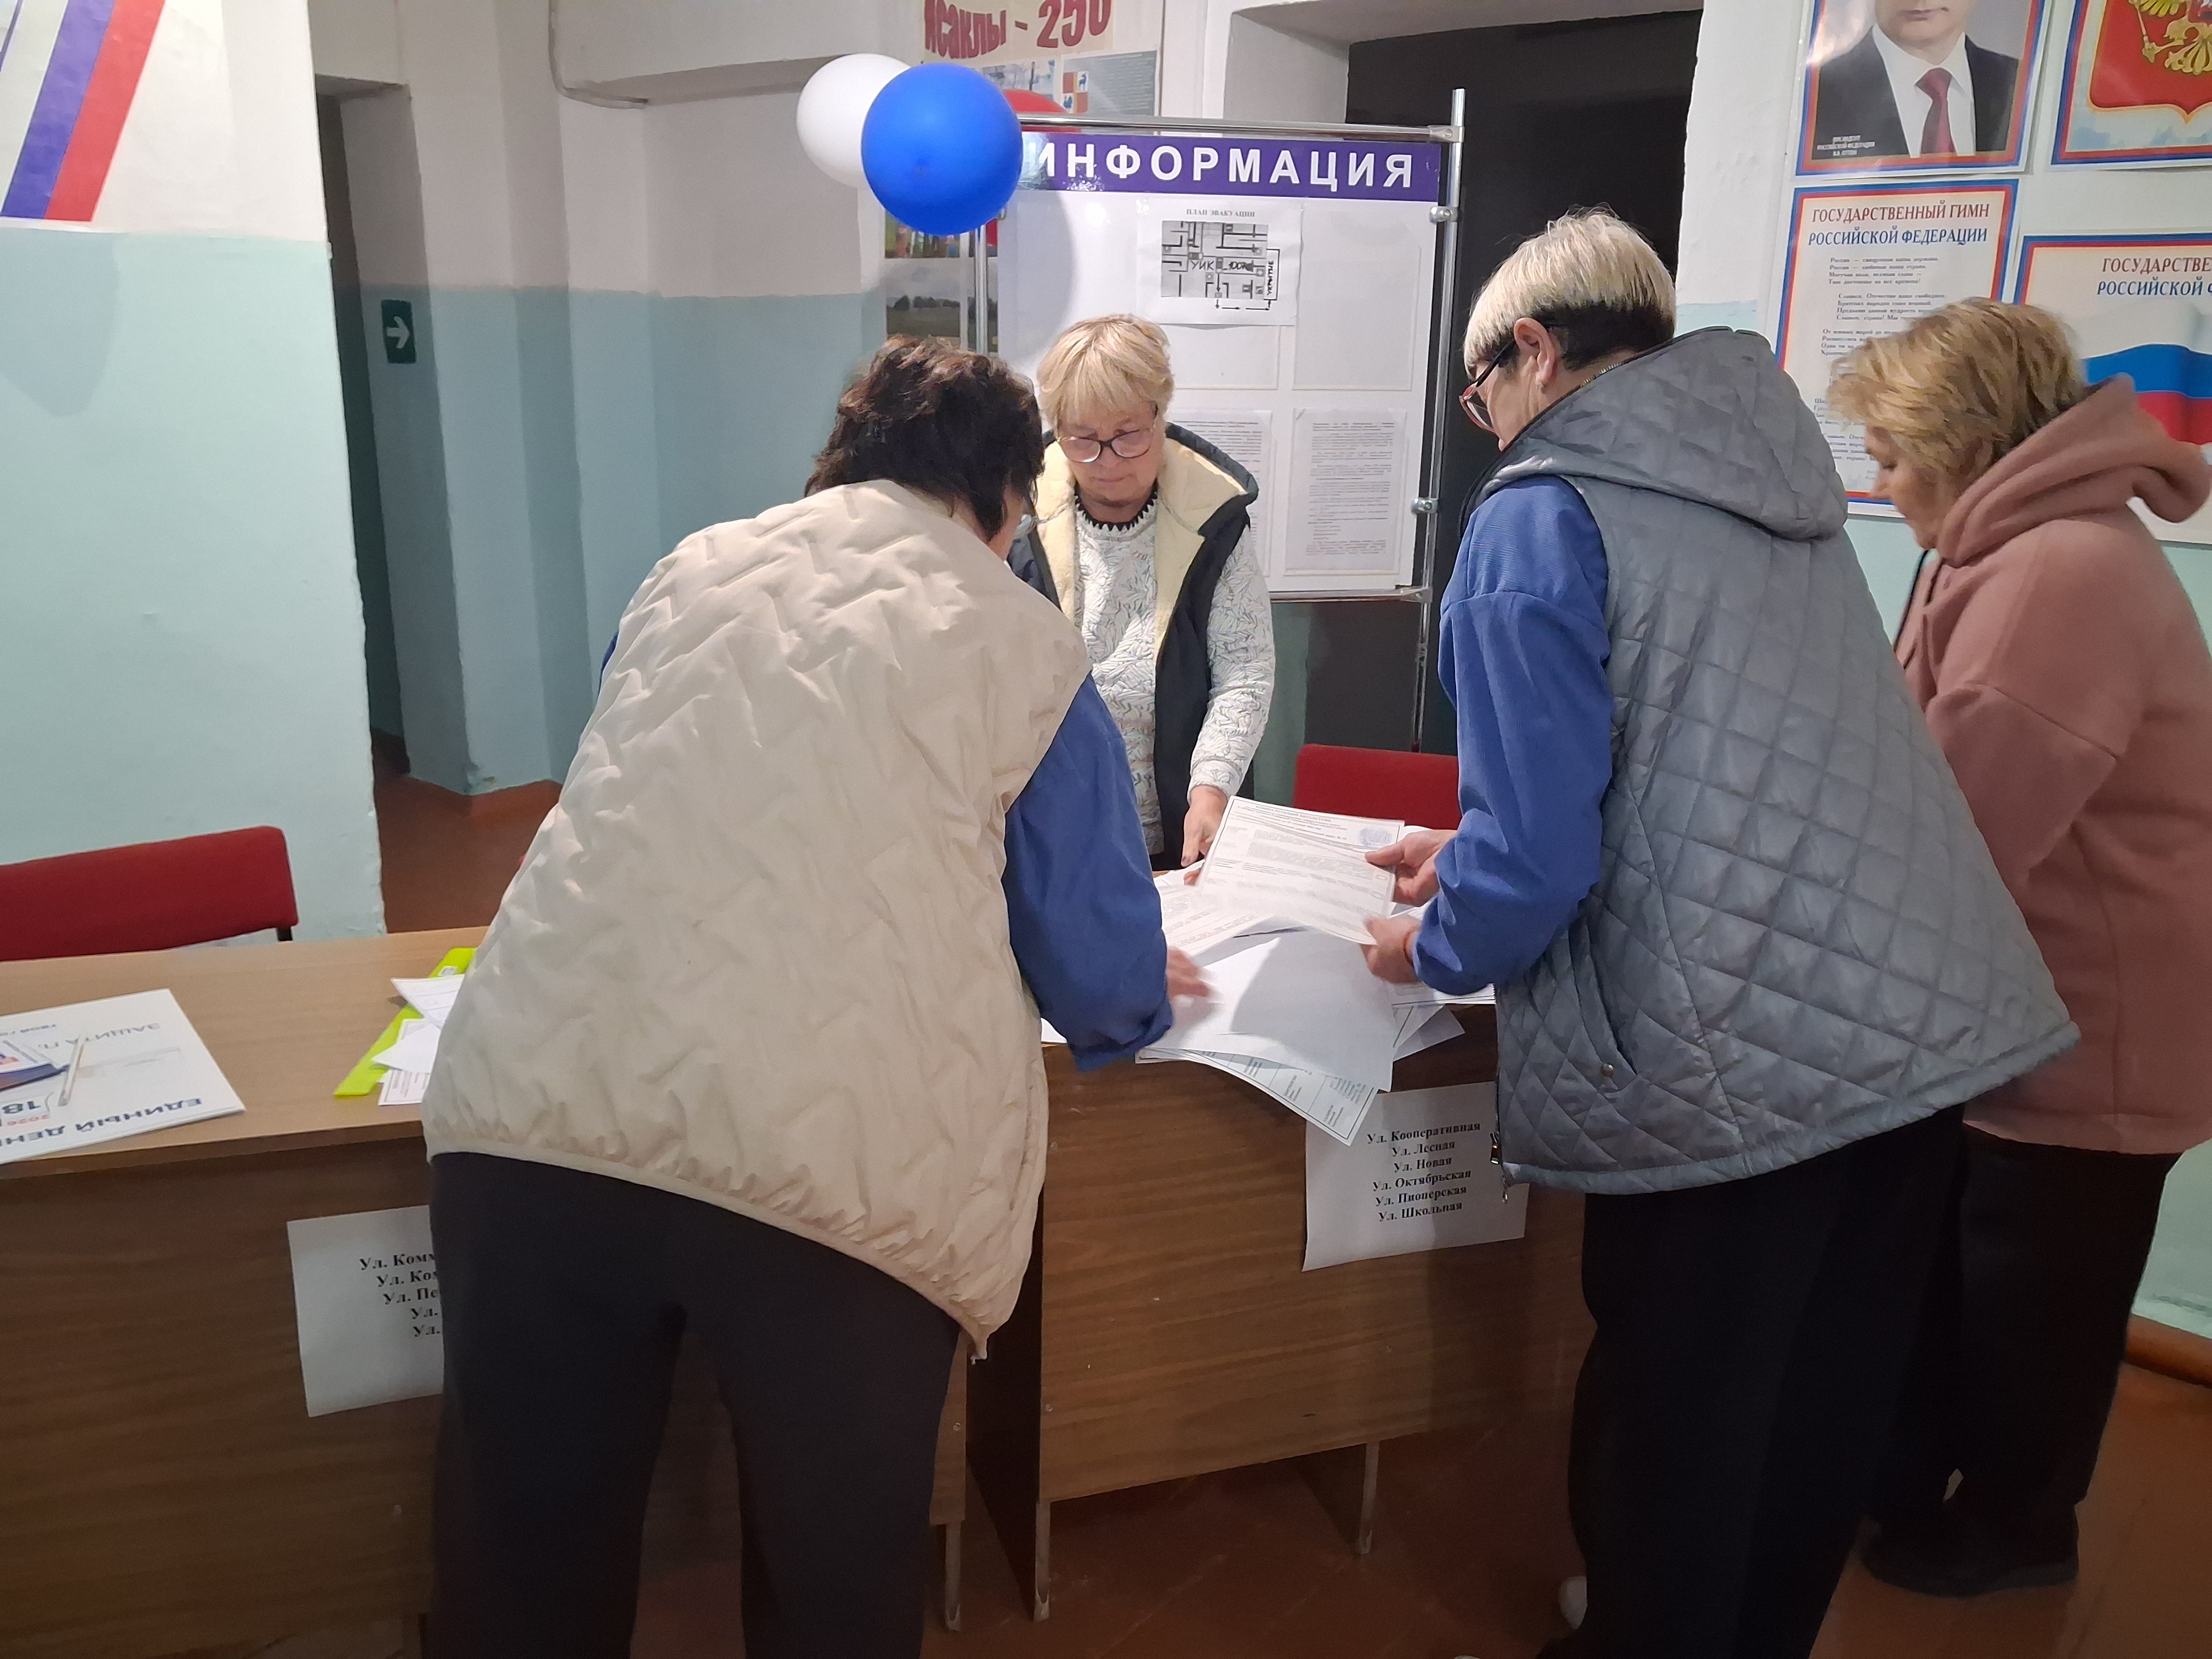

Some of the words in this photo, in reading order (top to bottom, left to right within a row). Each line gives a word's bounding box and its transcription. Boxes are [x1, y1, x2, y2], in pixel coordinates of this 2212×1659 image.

[1037, 0, 1111, 48] 250
[1030, 142, 1412, 192] ИНФОРМАЦИЯ
[1812, 200, 1946, 224] ГОСУДАРСТВЕННЫЙ
[1950, 204, 1989, 217] ГИМН
[1808, 226, 1898, 245] РОССИЙСКОЙ
[1902, 228, 1988, 245] ФЕДЕРАЦИИ
[1190, 261, 1214, 271] УИК
[2097, 276, 2203, 295] РОССИЙСКОЙ
[75, 1098, 201, 1133] ЕДИНЫЙ
[0, 1125, 66, 1146] ДЕН
[1367, 1133, 1387, 1144] Ул.
[1391, 1122, 1481, 1142] Кооперативная
[1392, 1146, 1411, 1157] Ул.
[1414, 1141, 1455, 1154] Лесная
[1394, 1162, 1412, 1173] Ул.
[1417, 1157, 1452, 1170] Новая
[1373, 1181, 1392, 1192] Ул.
[1395, 1169, 1471, 1188] Октябрьская
[1375, 1196, 1394, 1207] Ул.
[1398, 1186, 1467, 1204] Пионерская
[1379, 1211, 1398, 1222] Ул.
[1401, 1202, 1462, 1218] Школьная
[359, 1257, 388, 1270] Ул.
[376, 1274, 404, 1287] Ул.
[383, 1293, 411, 1304] Ул.
[410, 1307, 438, 1320] Ул.
[413, 1324, 440, 1337] Ул.
